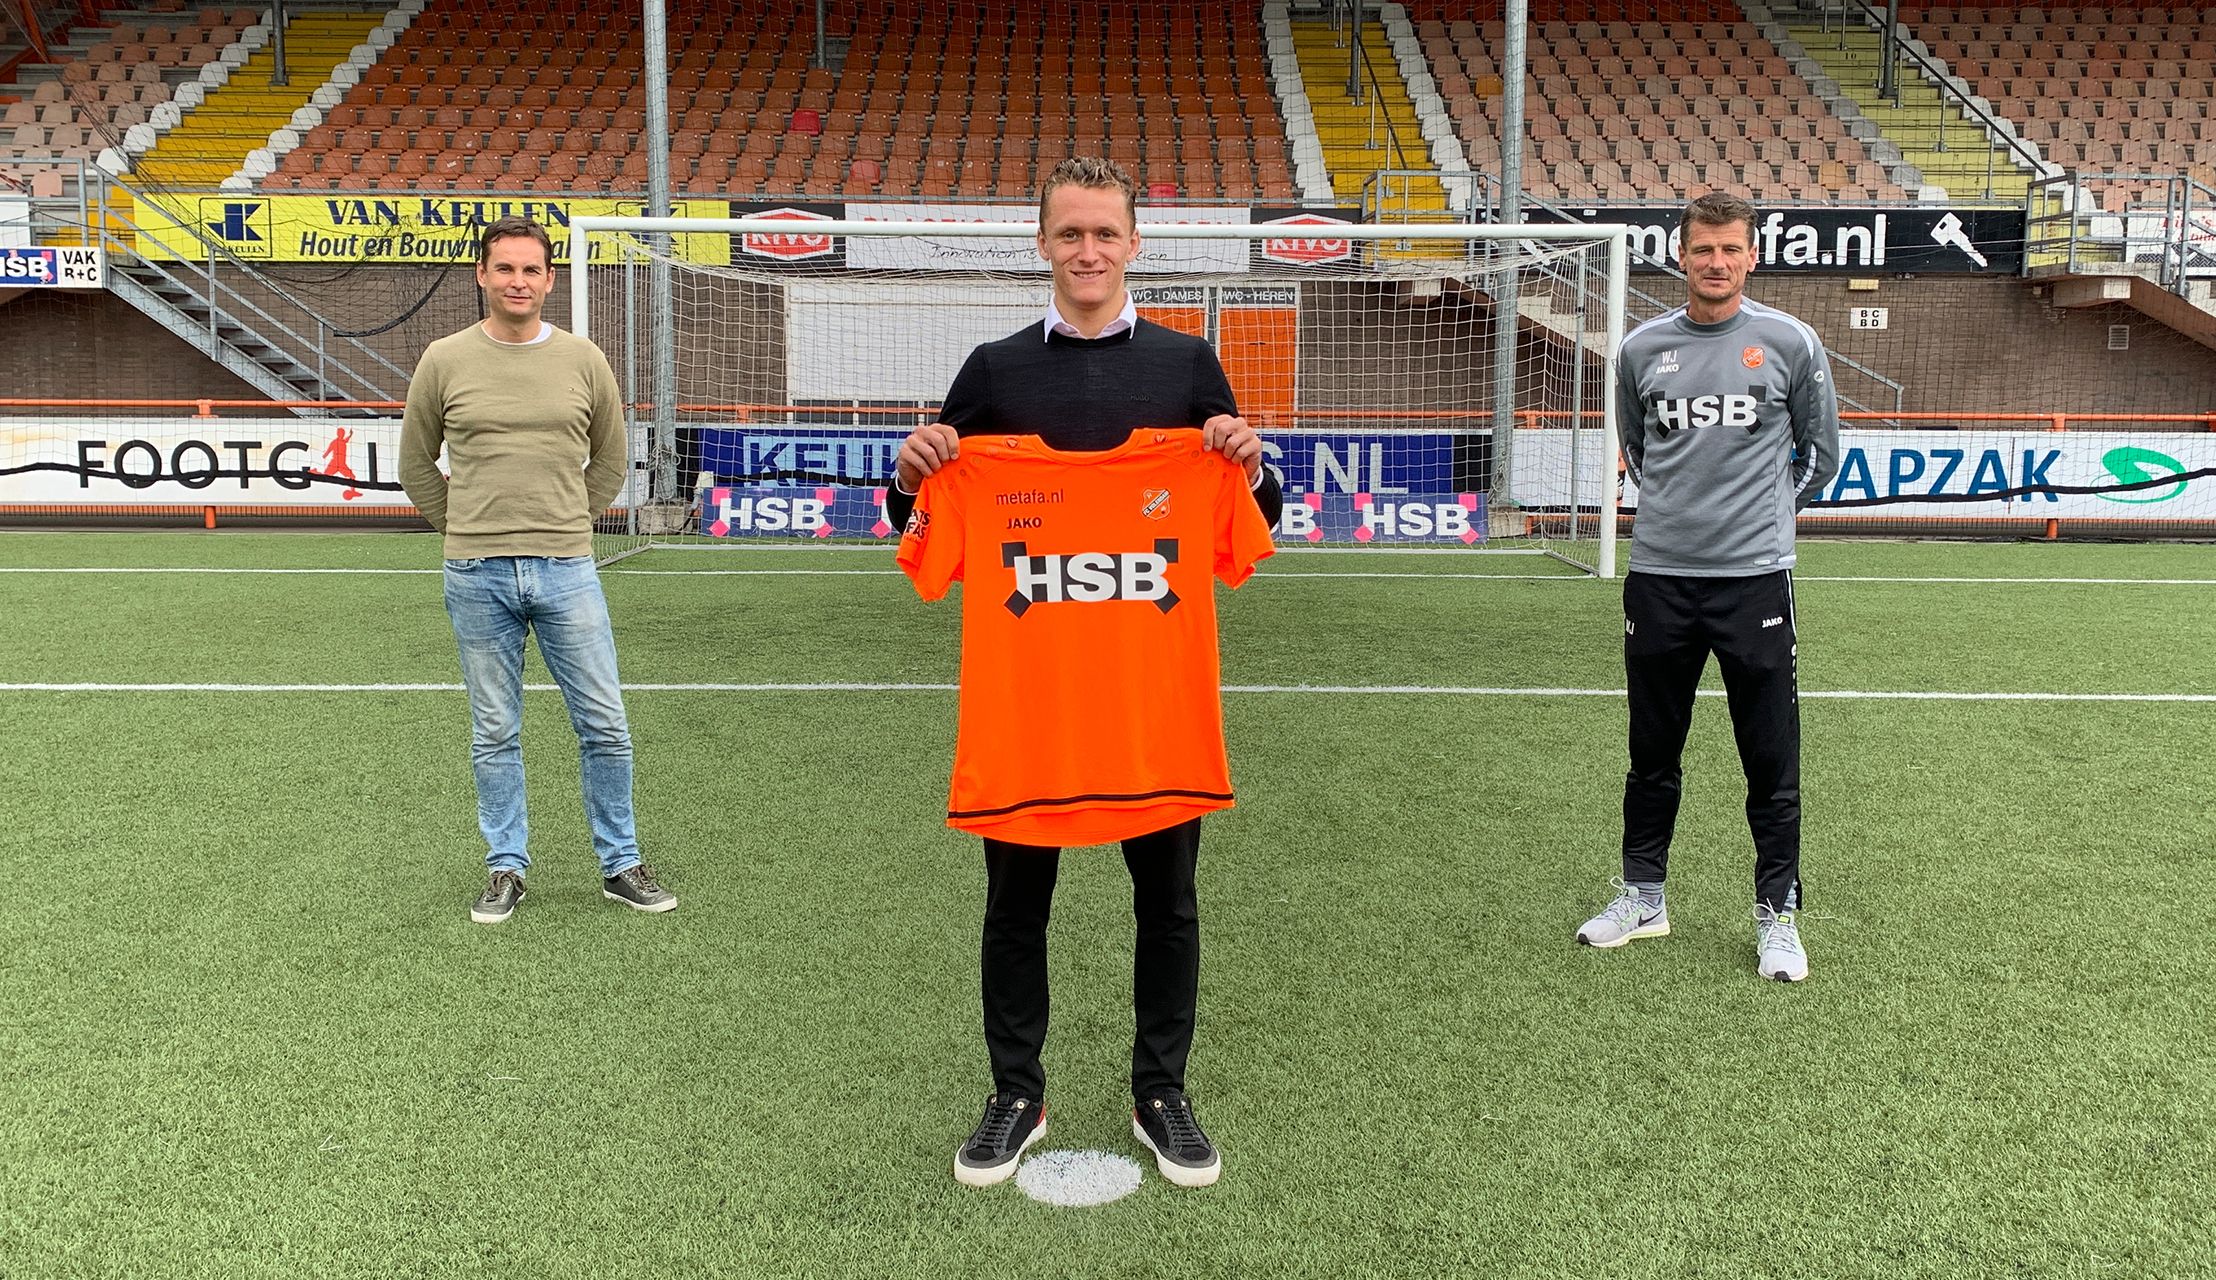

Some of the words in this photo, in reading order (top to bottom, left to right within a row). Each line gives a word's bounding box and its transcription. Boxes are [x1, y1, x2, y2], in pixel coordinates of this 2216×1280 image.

[325, 200, 400, 225] VAN
[300, 231, 358, 256] Hout
[364, 237, 393, 256] en
[63, 251, 96, 265] VAK
[1133, 291, 1152, 300] WC
[1162, 291, 1202, 301] DAMES
[1224, 291, 1243, 301] WC
[1254, 291, 1293, 301] HEREN
[1656, 364, 1679, 375] JAKO
[1657, 394, 1757, 430] HSB
[1812, 447, 2061, 503] APZAK
[995, 488, 1064, 506] metafa.nl
[719, 497, 828, 531] HSB
[1006, 516, 1043, 530] JAKO
[1362, 502, 1472, 537] HSB
[1013, 551, 1171, 603] HSB
[1761, 616, 1784, 629] JAKO
